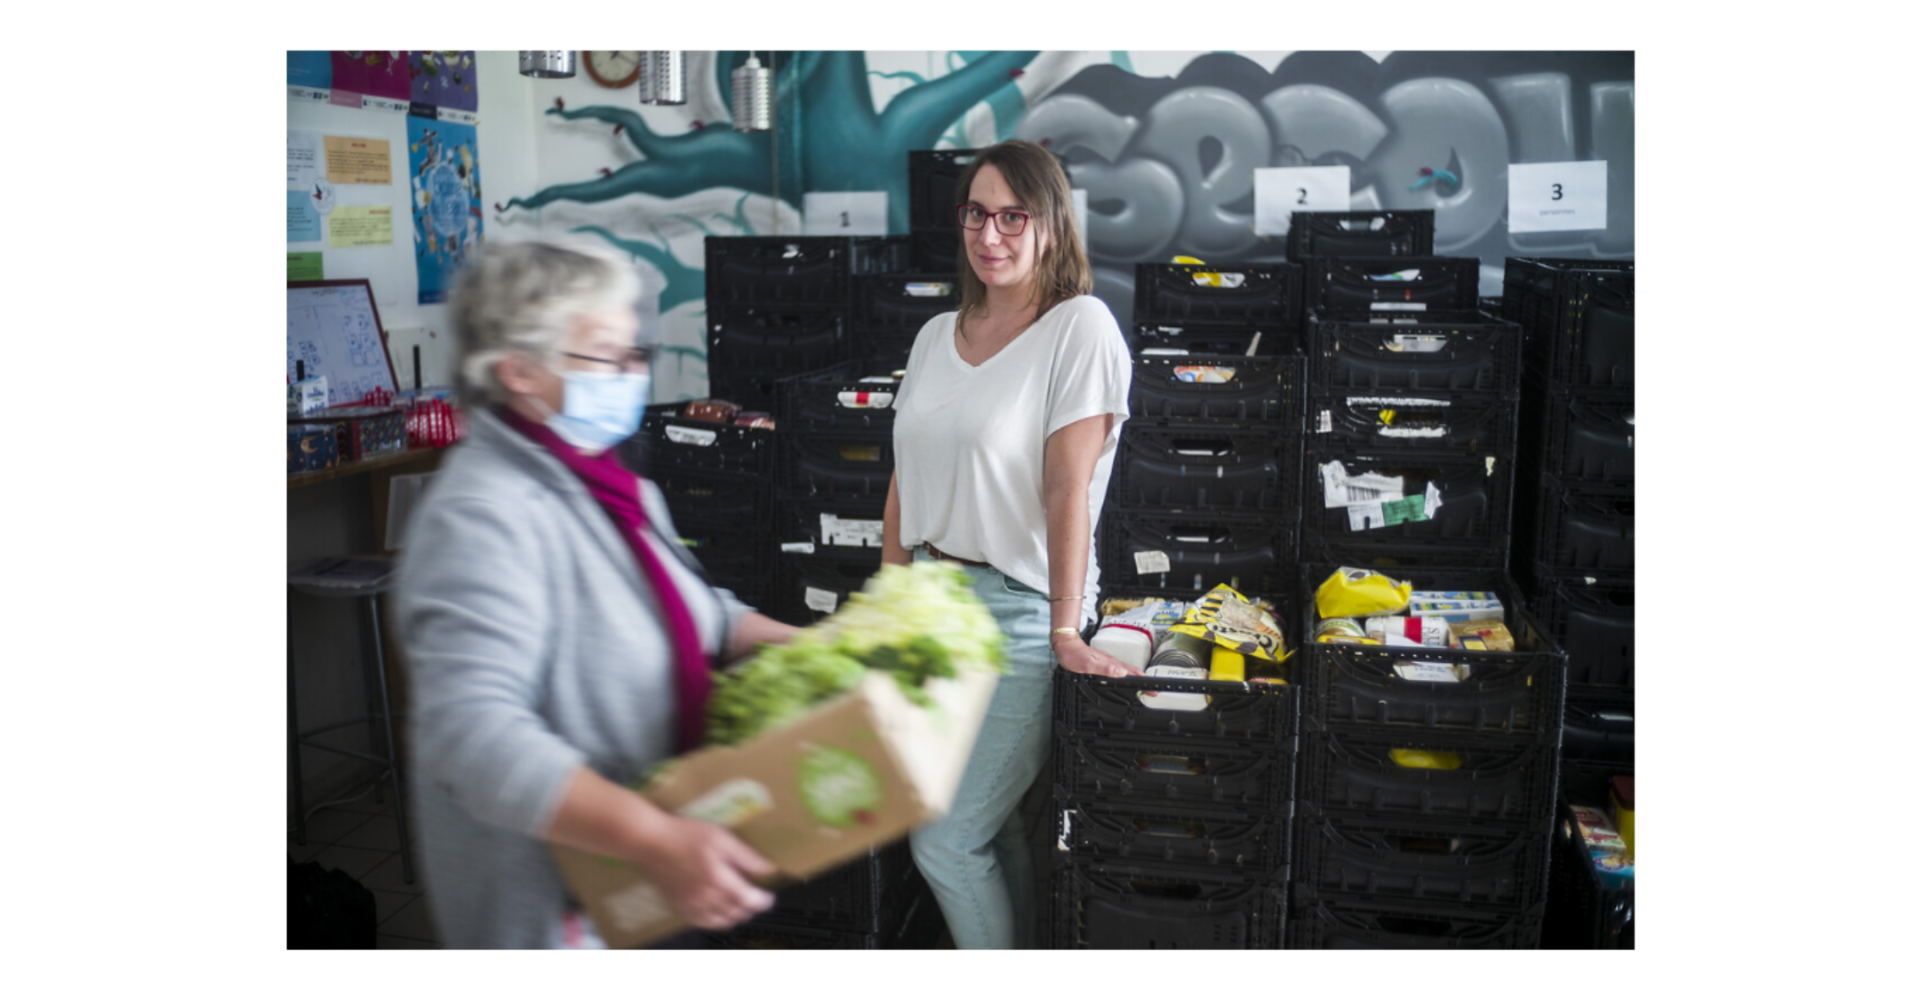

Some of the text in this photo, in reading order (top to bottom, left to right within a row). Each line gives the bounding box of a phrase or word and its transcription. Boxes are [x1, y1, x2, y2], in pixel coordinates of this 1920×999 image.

[1296, 187, 1308, 205] 2
[1551, 183, 1563, 201] 3
[839, 211, 850, 227] 1
[1539, 208, 1576, 217] personnes
